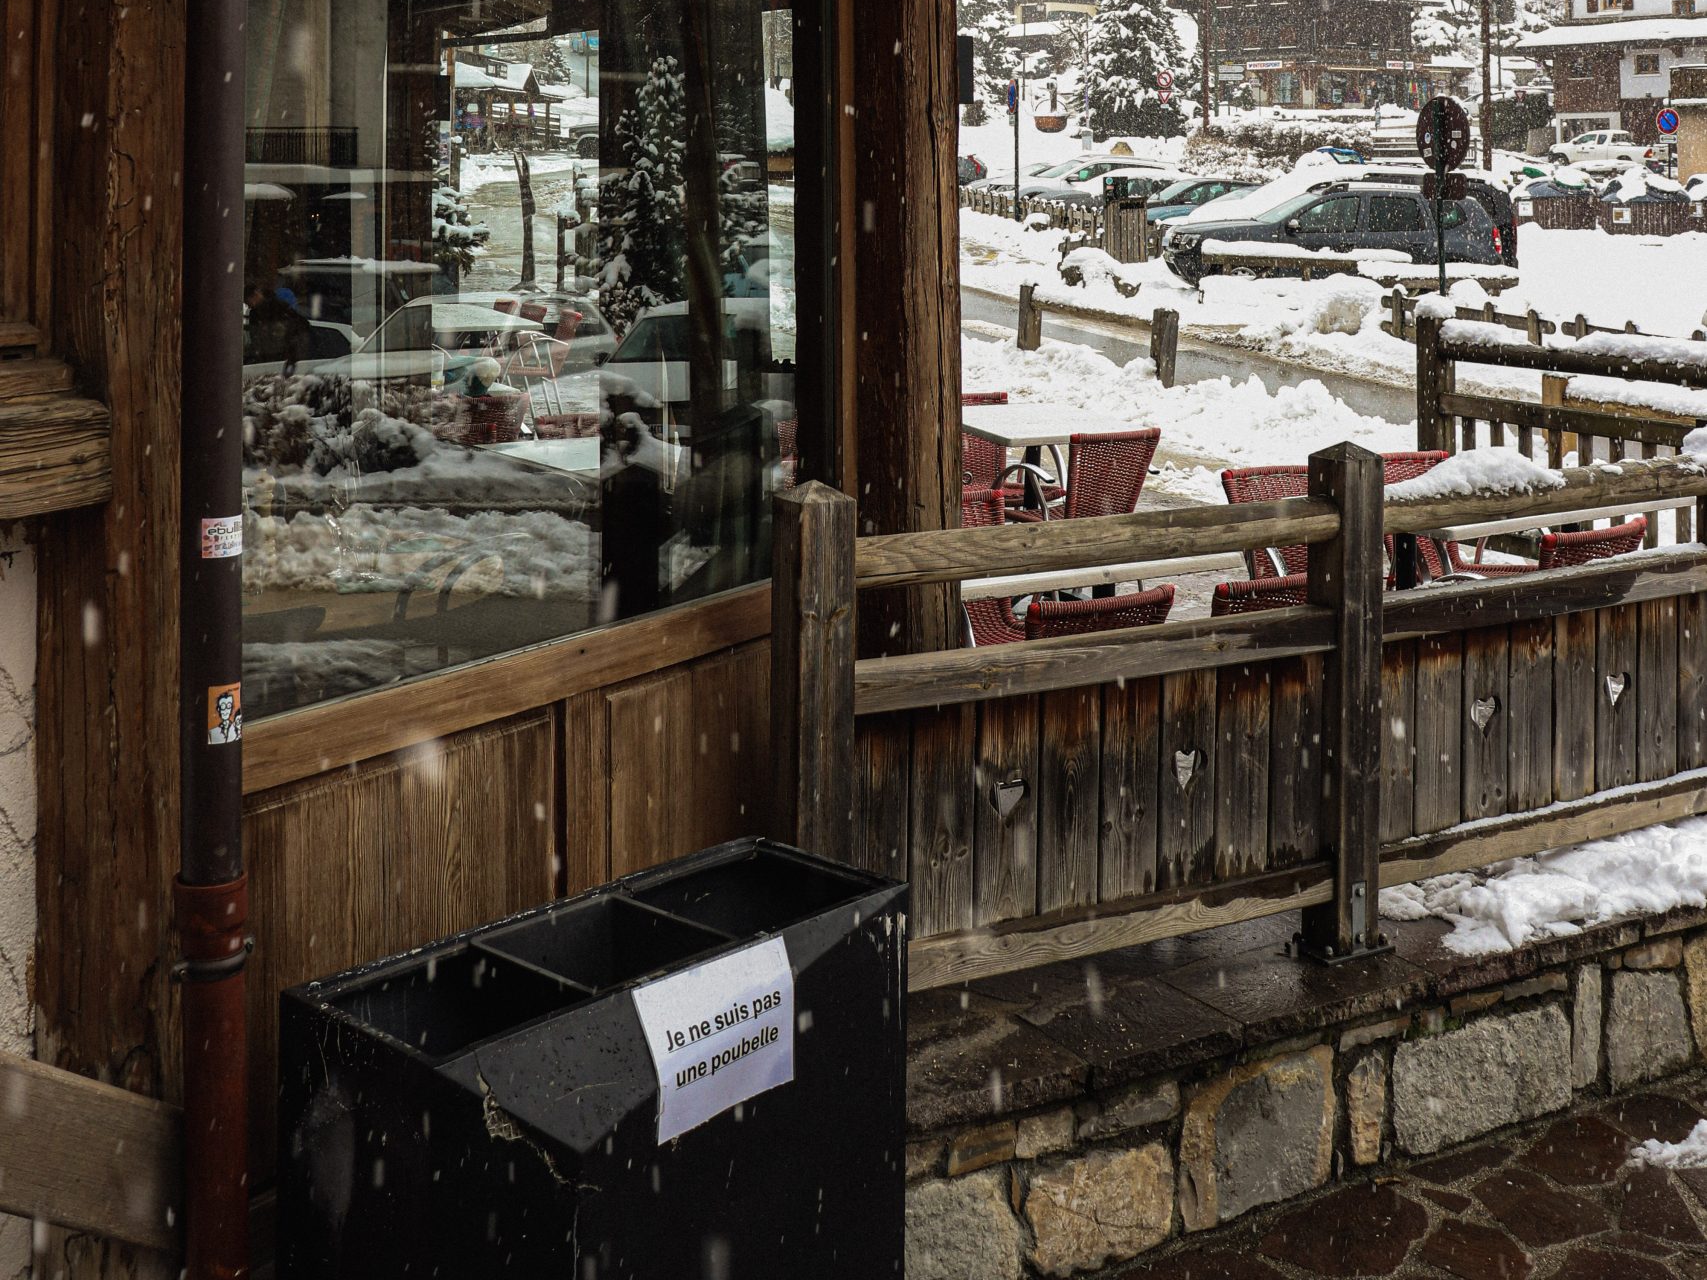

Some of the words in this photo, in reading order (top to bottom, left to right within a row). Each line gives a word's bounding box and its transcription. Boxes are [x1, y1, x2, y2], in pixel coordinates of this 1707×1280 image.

[666, 1029, 686, 1051] Je
[689, 1020, 711, 1042] ne
[714, 1003, 750, 1031] suis
[752, 990, 781, 1019] pas
[676, 1061, 707, 1087] une
[711, 1025, 779, 1075] poubelle
